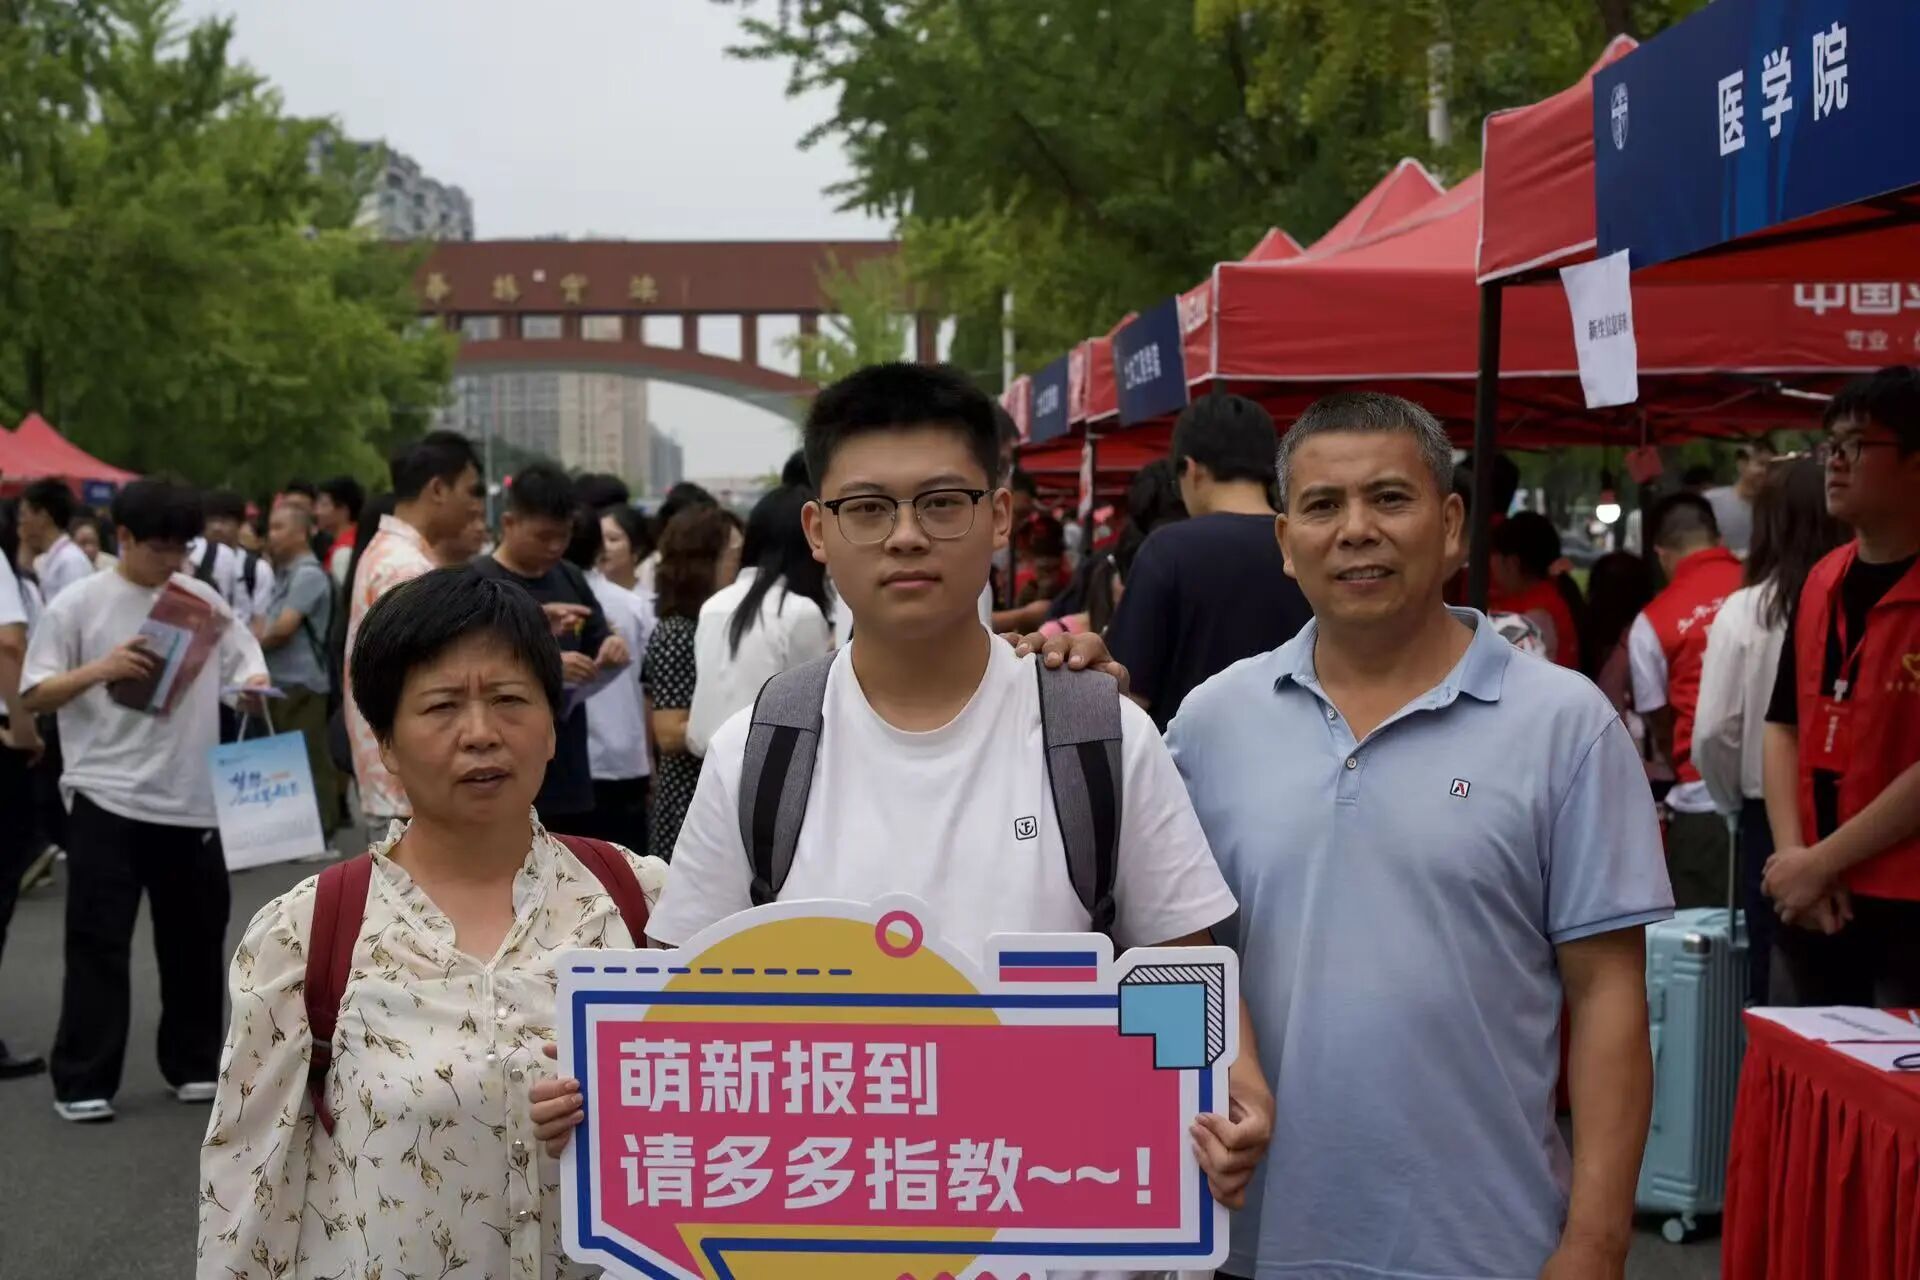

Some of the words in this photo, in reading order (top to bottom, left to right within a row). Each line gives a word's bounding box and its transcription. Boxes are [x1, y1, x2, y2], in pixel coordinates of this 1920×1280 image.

[1717, 22, 1849, 156] 医学院
[619, 1038, 938, 1115] 萌新报到
